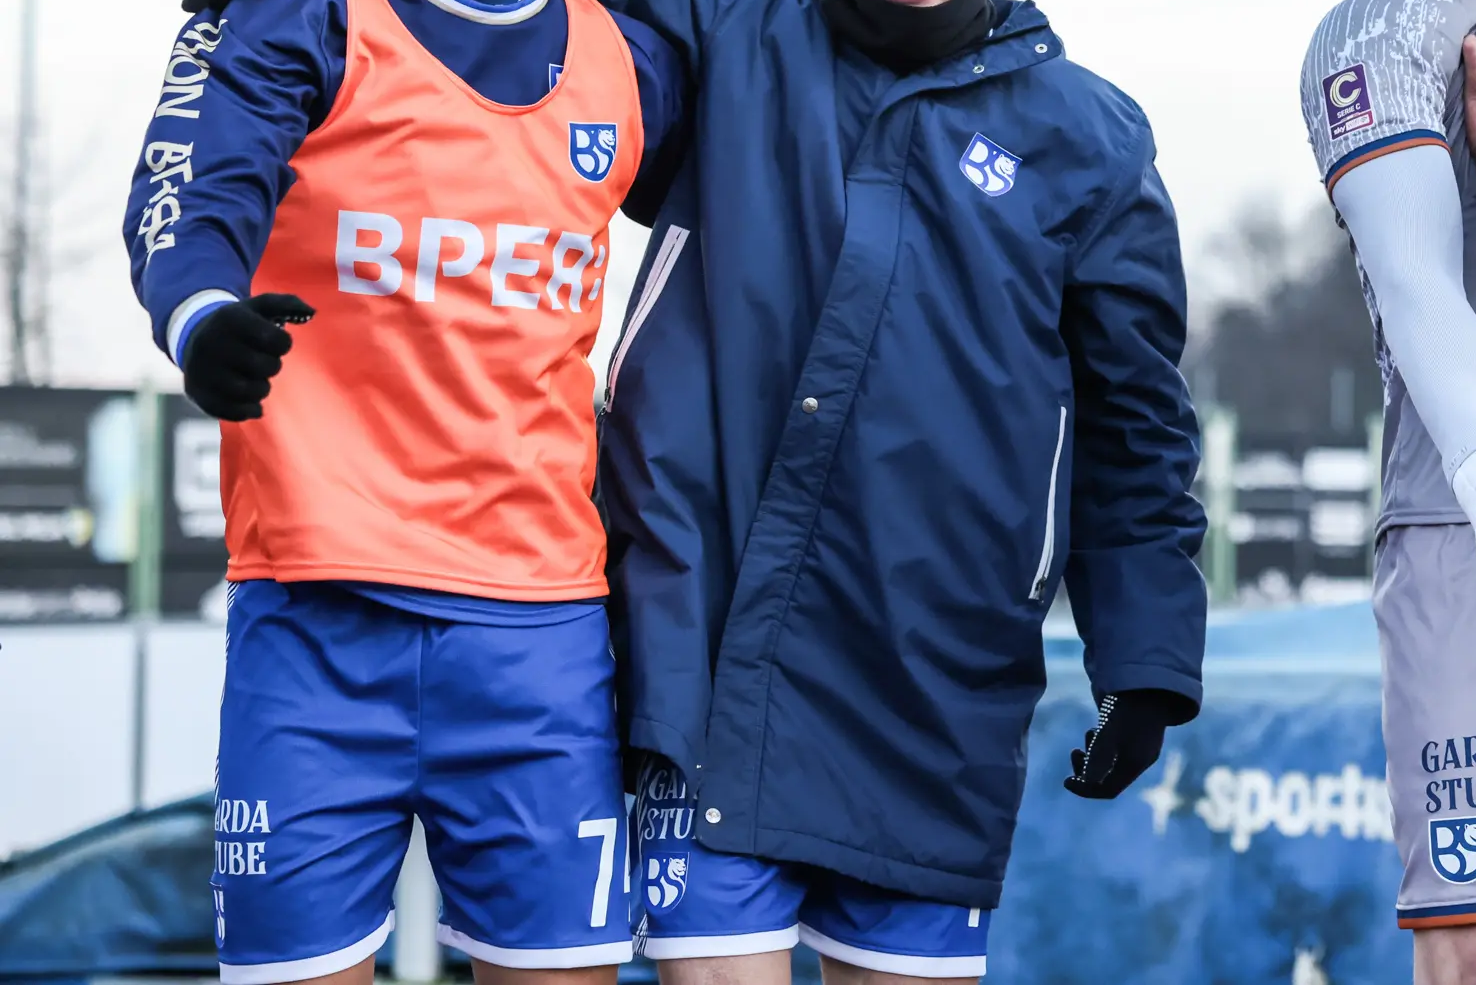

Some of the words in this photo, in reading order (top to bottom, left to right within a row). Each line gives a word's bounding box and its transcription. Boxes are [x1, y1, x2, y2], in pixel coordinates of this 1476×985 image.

[1336, 105, 1356, 119] SERIE
[1355, 102, 1361, 111] C
[644, 807, 703, 840] STU
